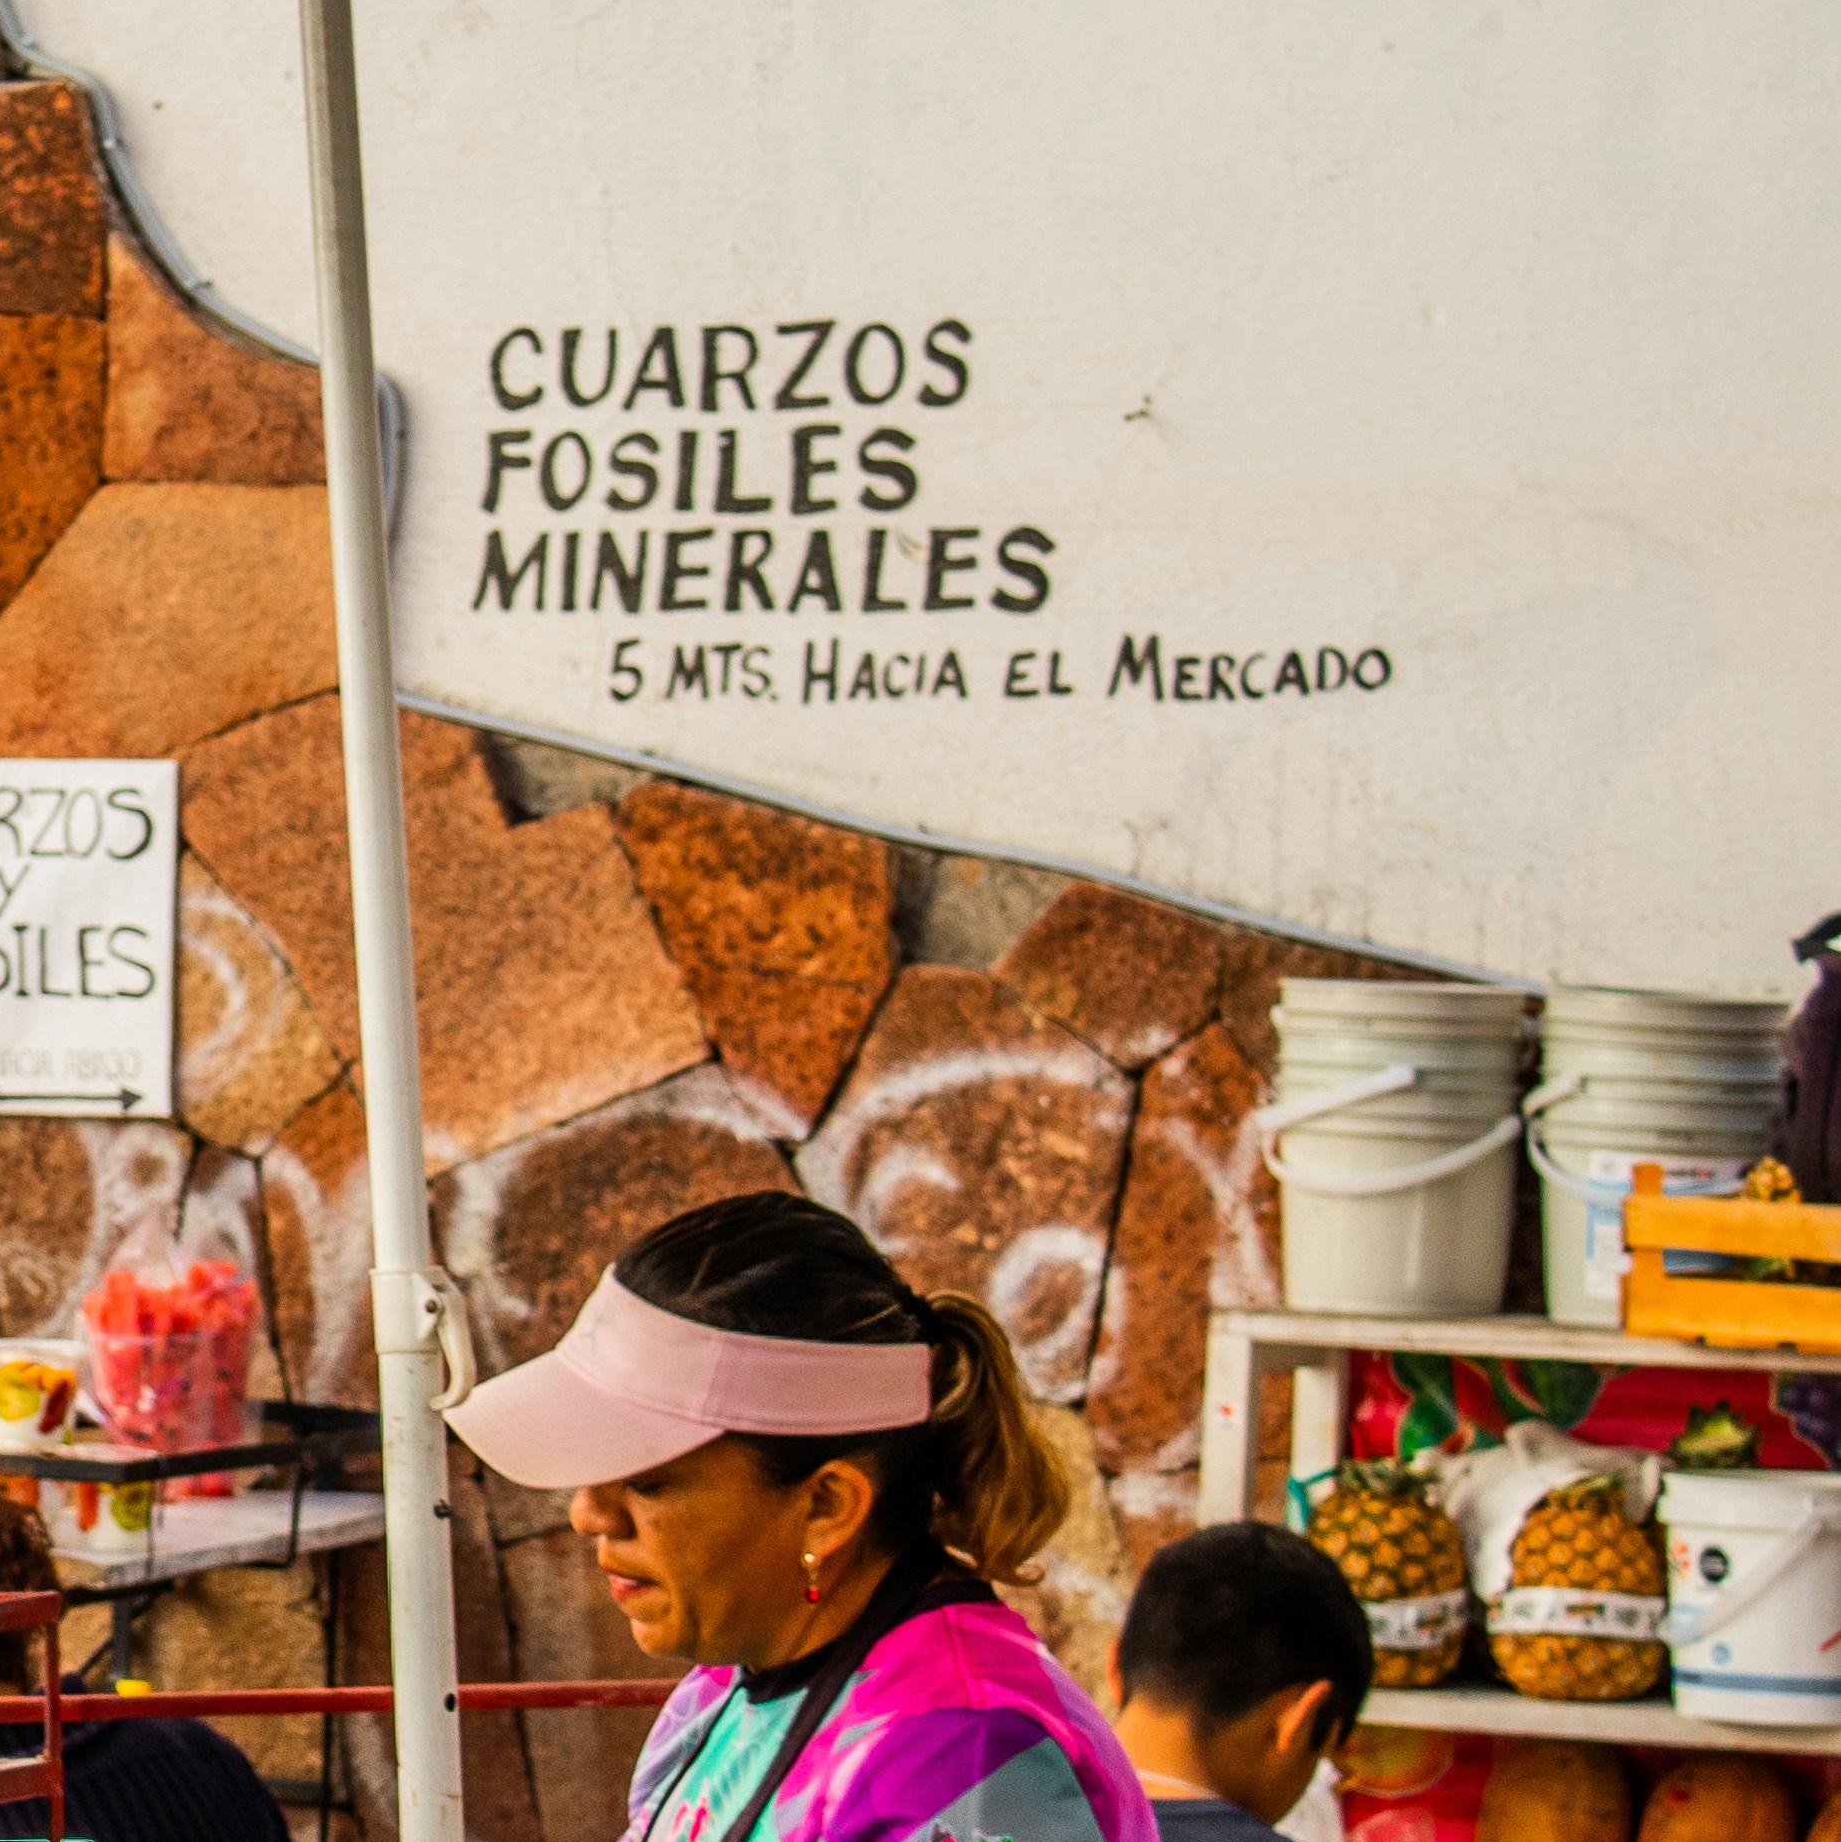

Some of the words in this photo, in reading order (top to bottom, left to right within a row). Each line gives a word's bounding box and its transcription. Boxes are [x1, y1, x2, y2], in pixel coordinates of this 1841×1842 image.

[488, 317, 974, 413] CUARZOS
[479, 423, 920, 516] FOSILES
[471, 524, 1057, 614] MINERALES
[608, 638, 643, 702] 5
[665, 641, 778, 703] MTS.
[1004, 648, 1073, 698] EL
[1108, 633, 1392, 702] MERCADO
